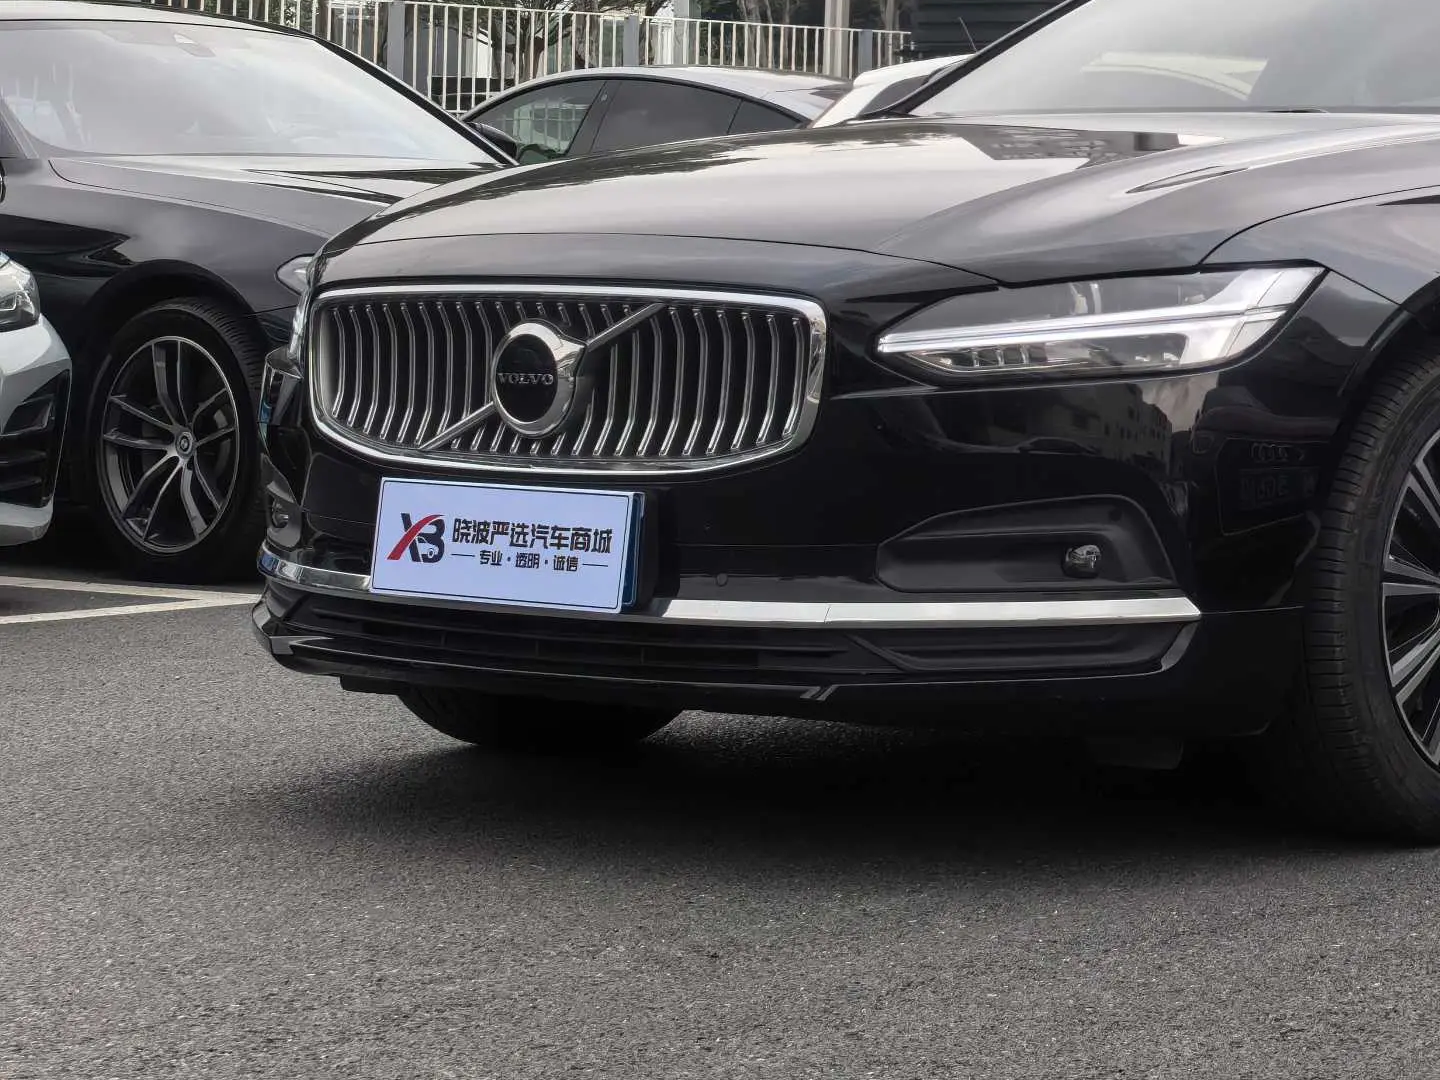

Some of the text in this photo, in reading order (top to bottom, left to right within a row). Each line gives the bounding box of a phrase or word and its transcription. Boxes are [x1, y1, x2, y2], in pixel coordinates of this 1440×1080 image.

[497, 372, 554, 385] VOLVO
[452, 518, 613, 554] 晓波严选汽车商城
